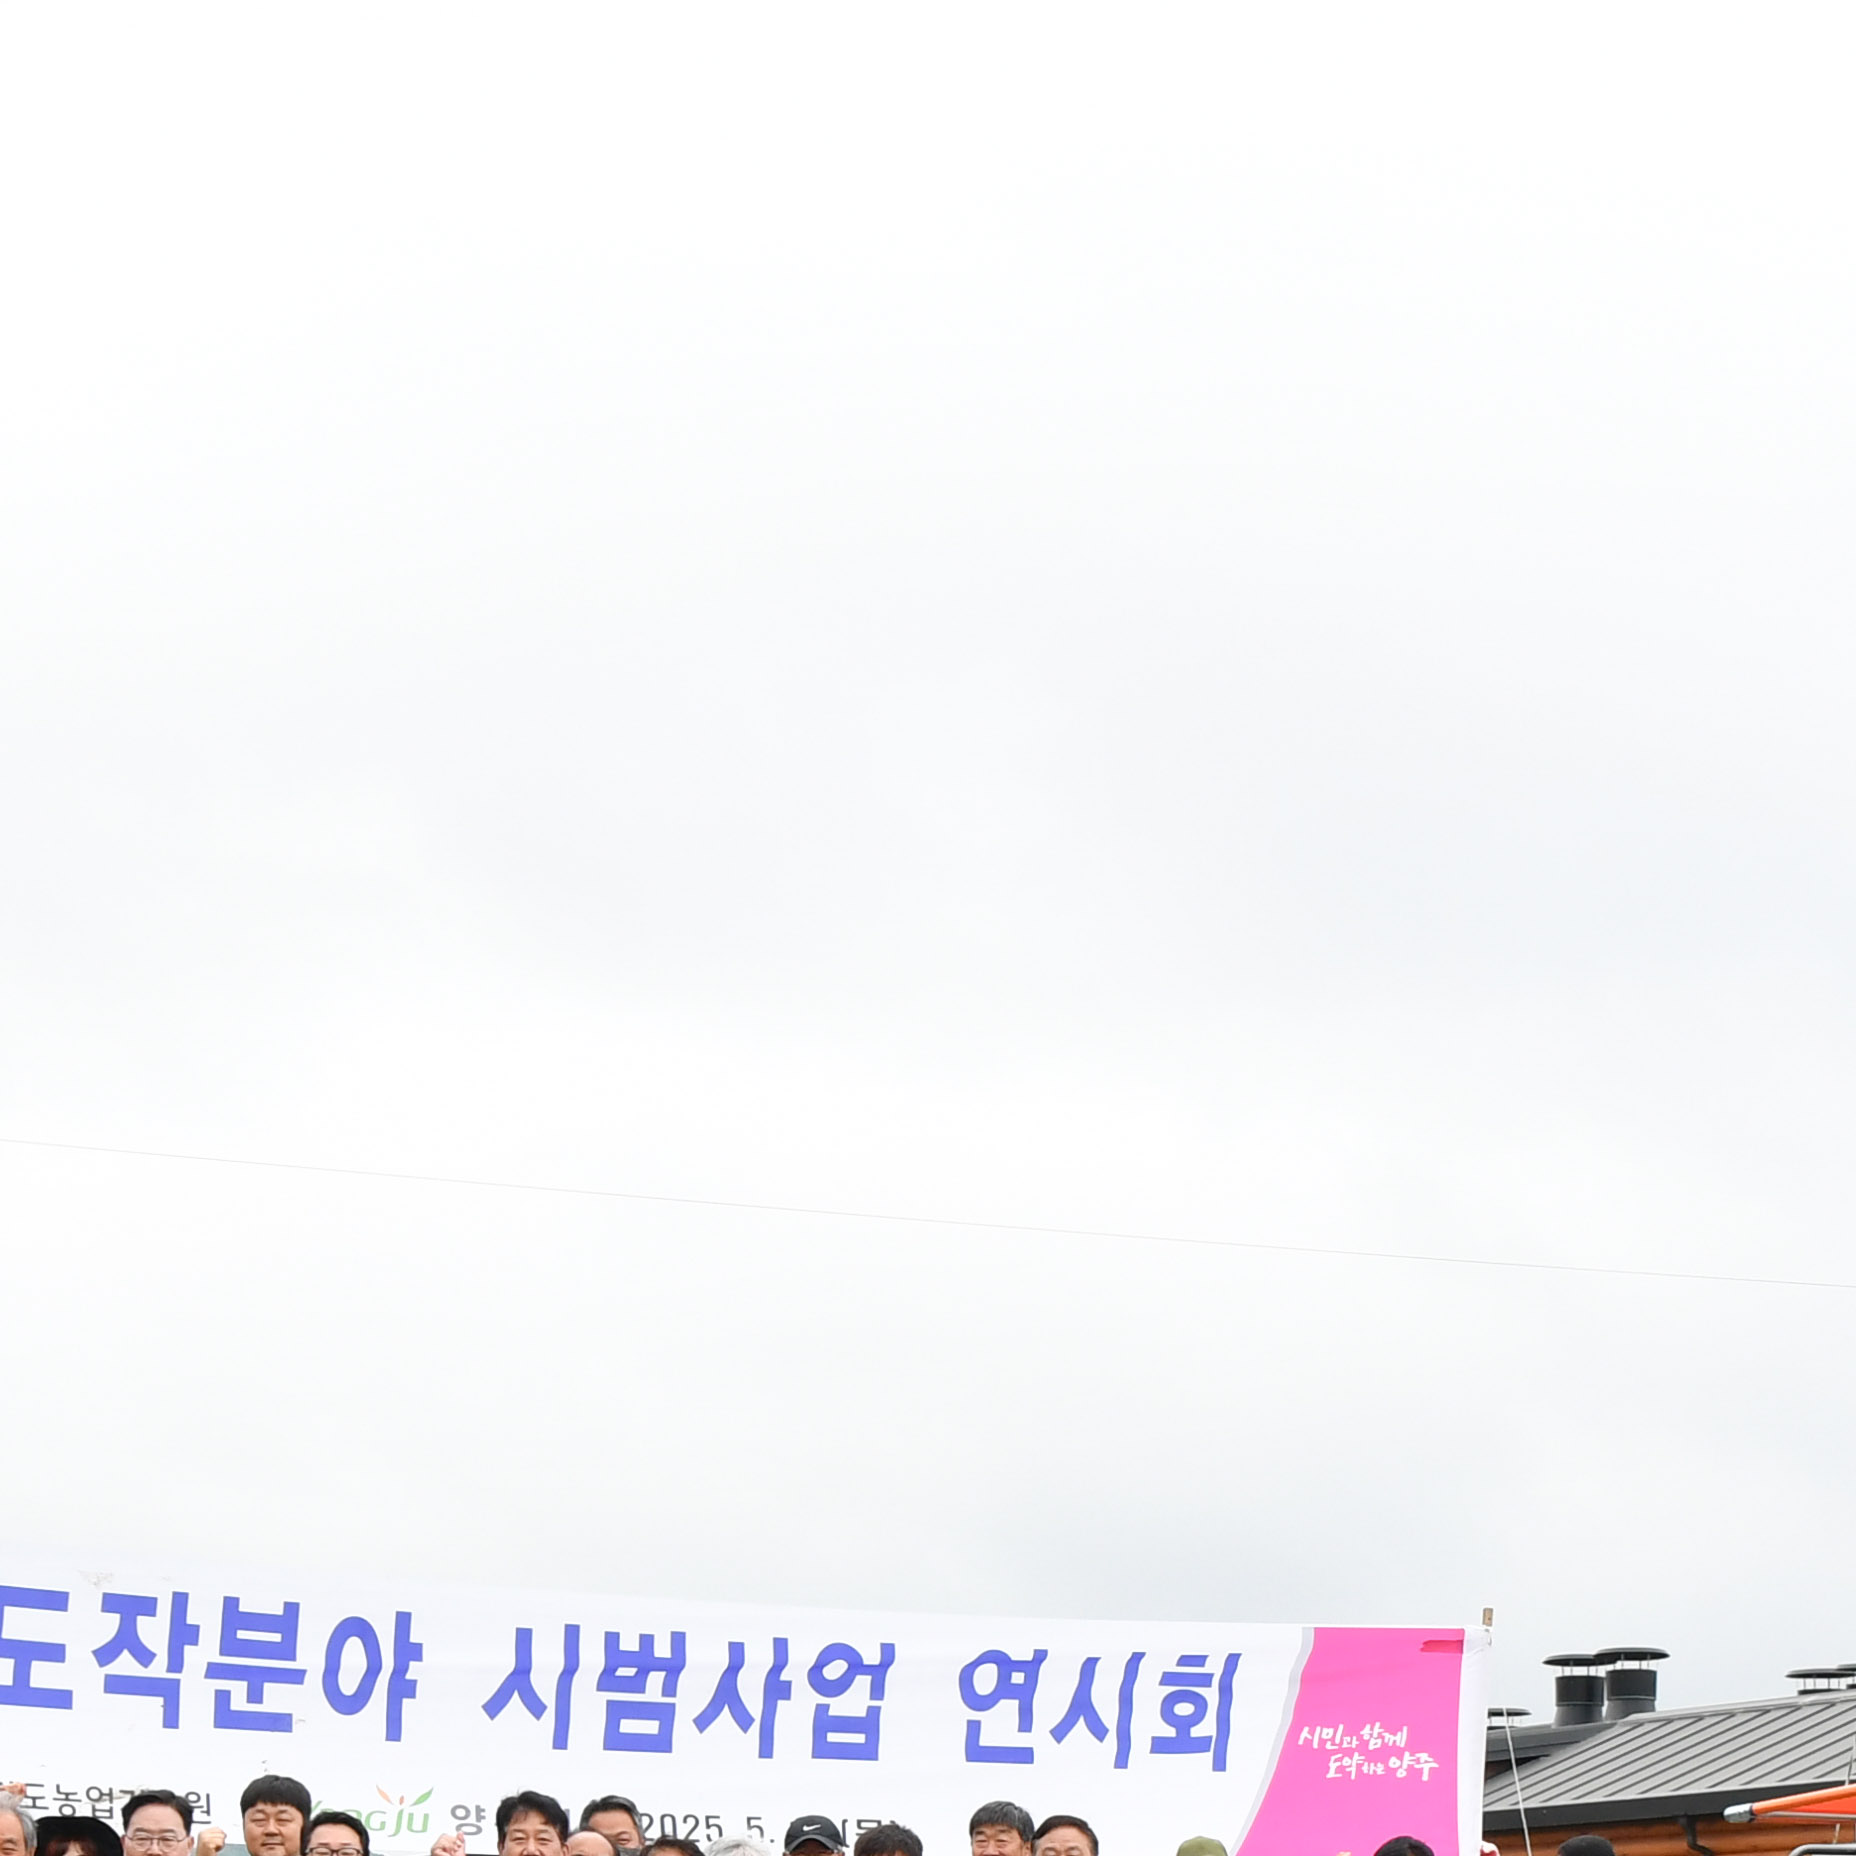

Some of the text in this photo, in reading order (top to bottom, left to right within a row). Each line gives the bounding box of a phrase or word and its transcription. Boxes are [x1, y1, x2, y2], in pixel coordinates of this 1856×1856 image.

[482, 1623, 896, 1761] 시범사업
[958, 1649, 1242, 1772] 연시회
[1297, 1721, 1408, 1750] 시민과 함께
[1325, 1751, 1440, 1782] 도약하는 양주
